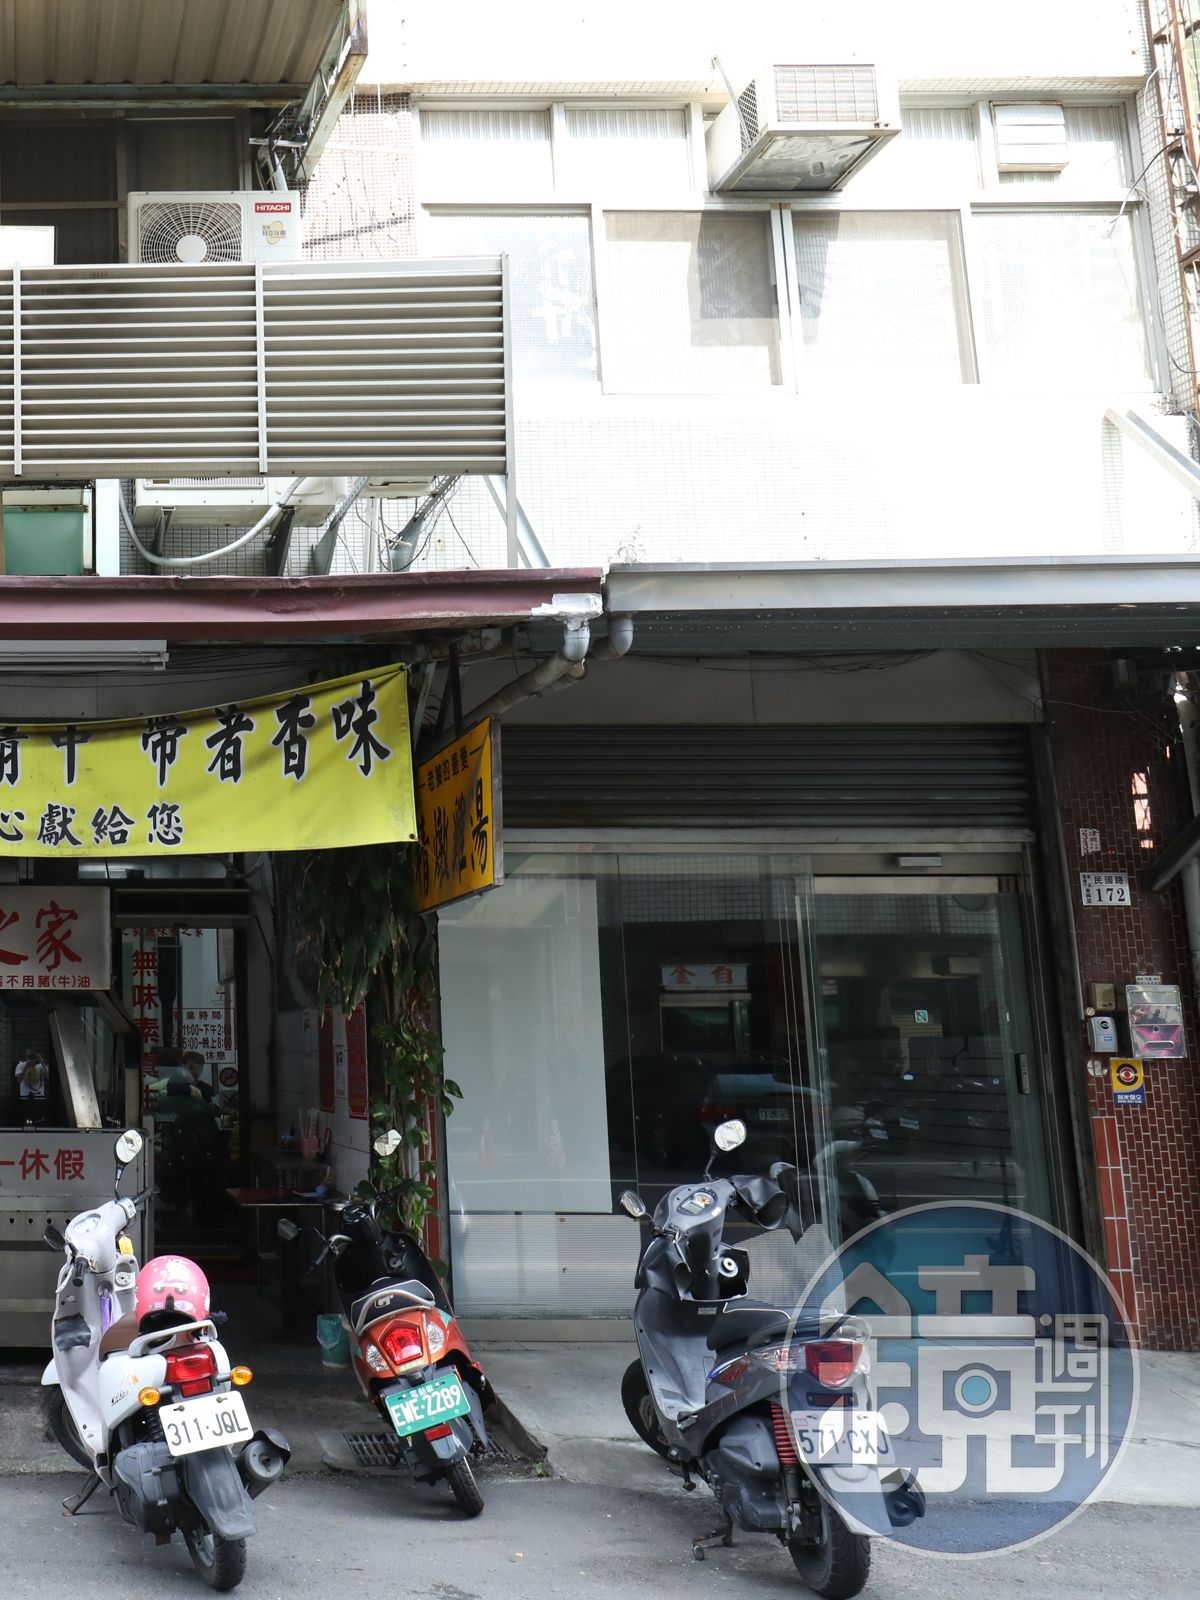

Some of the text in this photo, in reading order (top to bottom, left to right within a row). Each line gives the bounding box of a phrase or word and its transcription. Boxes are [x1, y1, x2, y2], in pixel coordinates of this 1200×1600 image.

[1094, 875, 1124, 885] 民國路
[1096, 887, 1126, 902] 172
